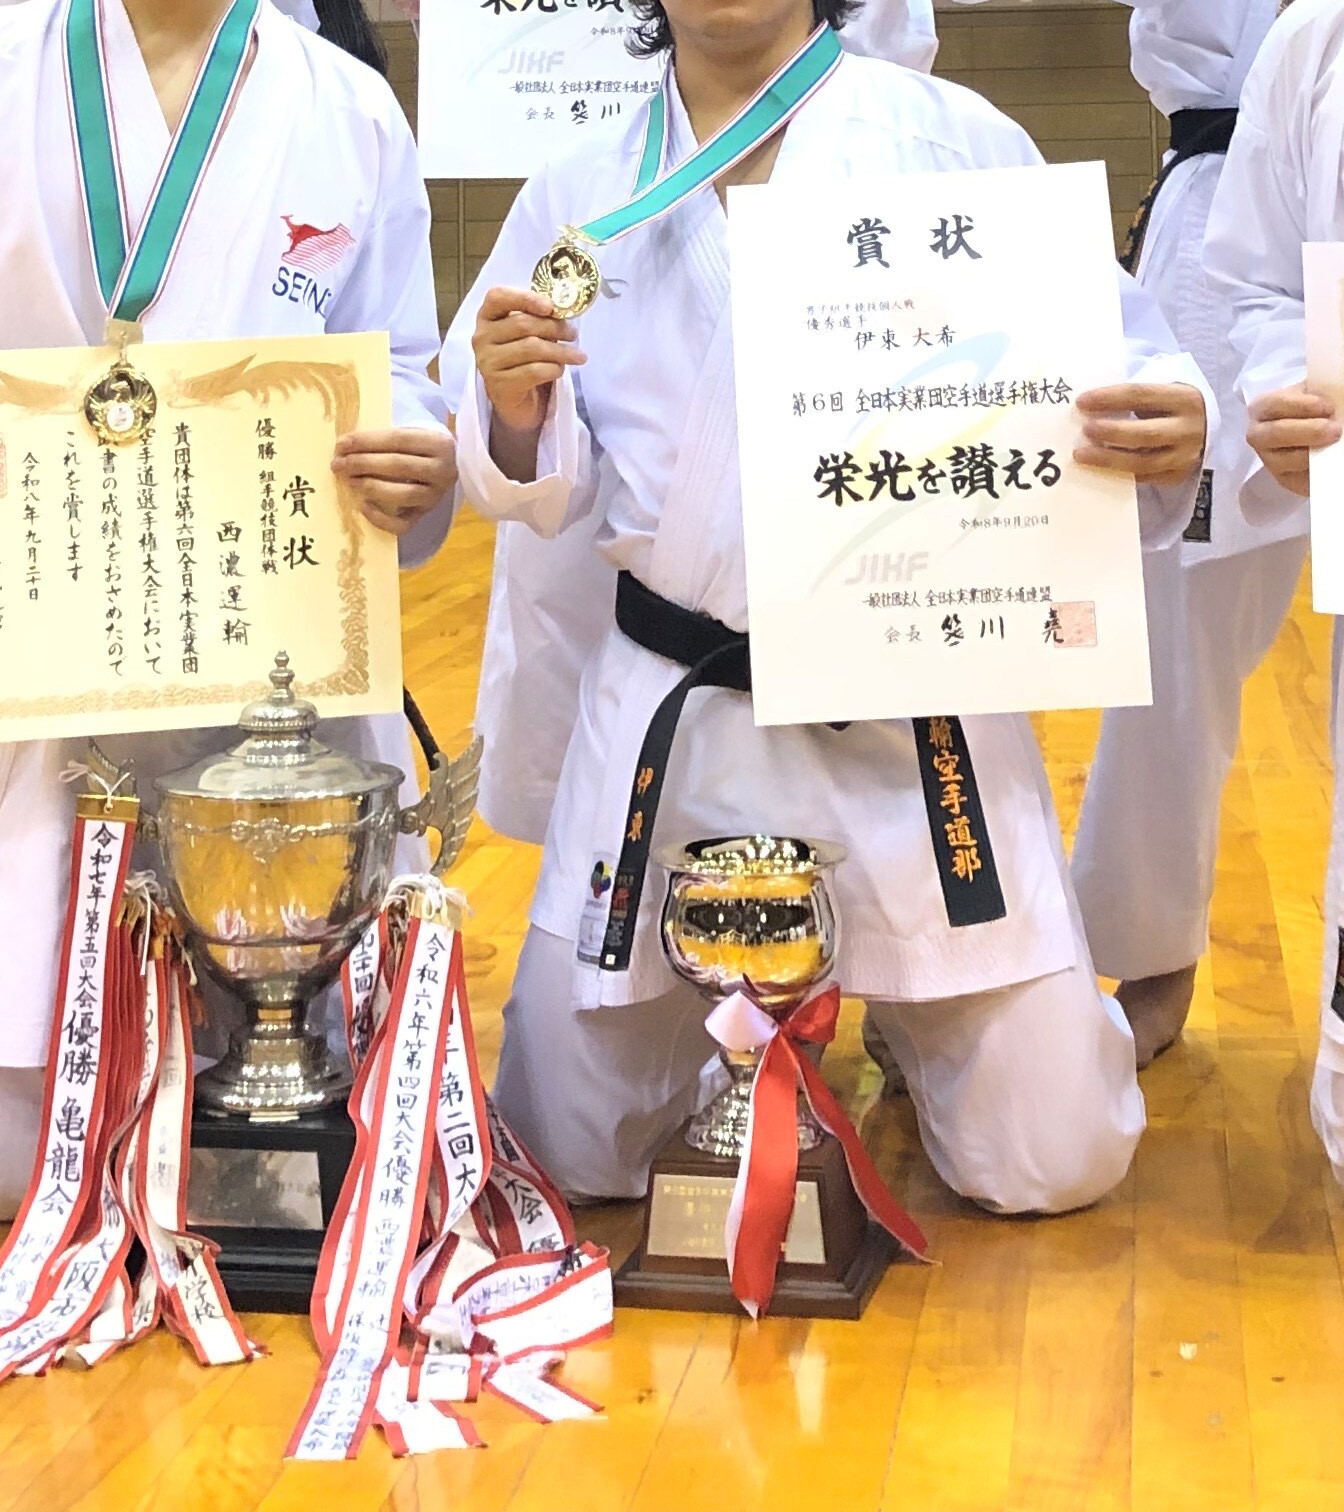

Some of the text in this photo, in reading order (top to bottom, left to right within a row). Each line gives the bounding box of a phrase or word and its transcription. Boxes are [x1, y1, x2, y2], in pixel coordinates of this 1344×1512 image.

[846, 214, 983, 269] 賞状
[272, 265, 333, 320] SEIN
[254, 417, 278, 460] 優勝
[61, 429, 86, 582] これを賞します
[813, 442, 1063, 508] 栄光を讃える
[282, 473, 321, 569] 賞状
[216, 520, 253, 646] 西濃運輸
